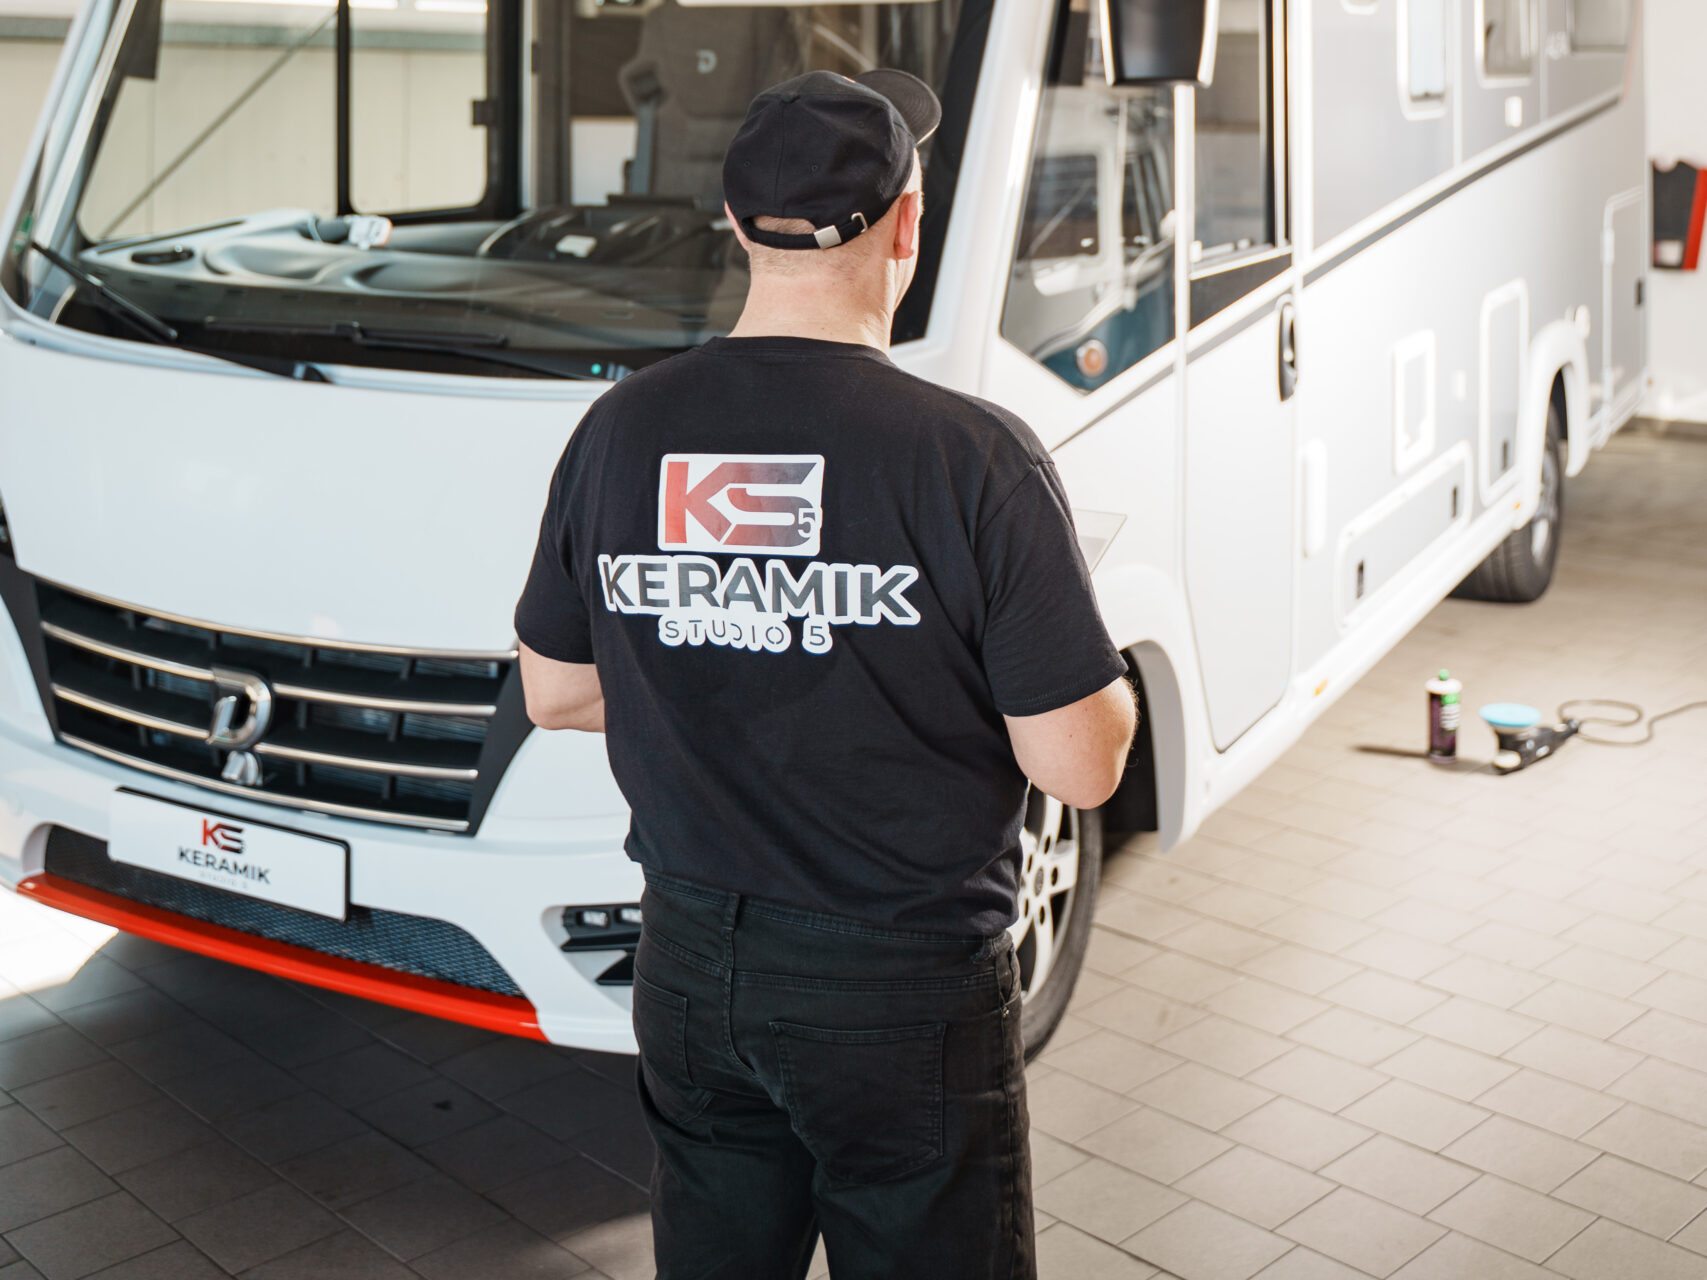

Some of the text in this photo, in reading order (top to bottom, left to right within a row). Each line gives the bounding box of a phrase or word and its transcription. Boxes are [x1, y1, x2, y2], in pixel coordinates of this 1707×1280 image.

[602, 561, 913, 619] KERAMIK
[665, 620, 826, 647] STUDIO 5
[178, 847, 271, 885] KERAMIK
